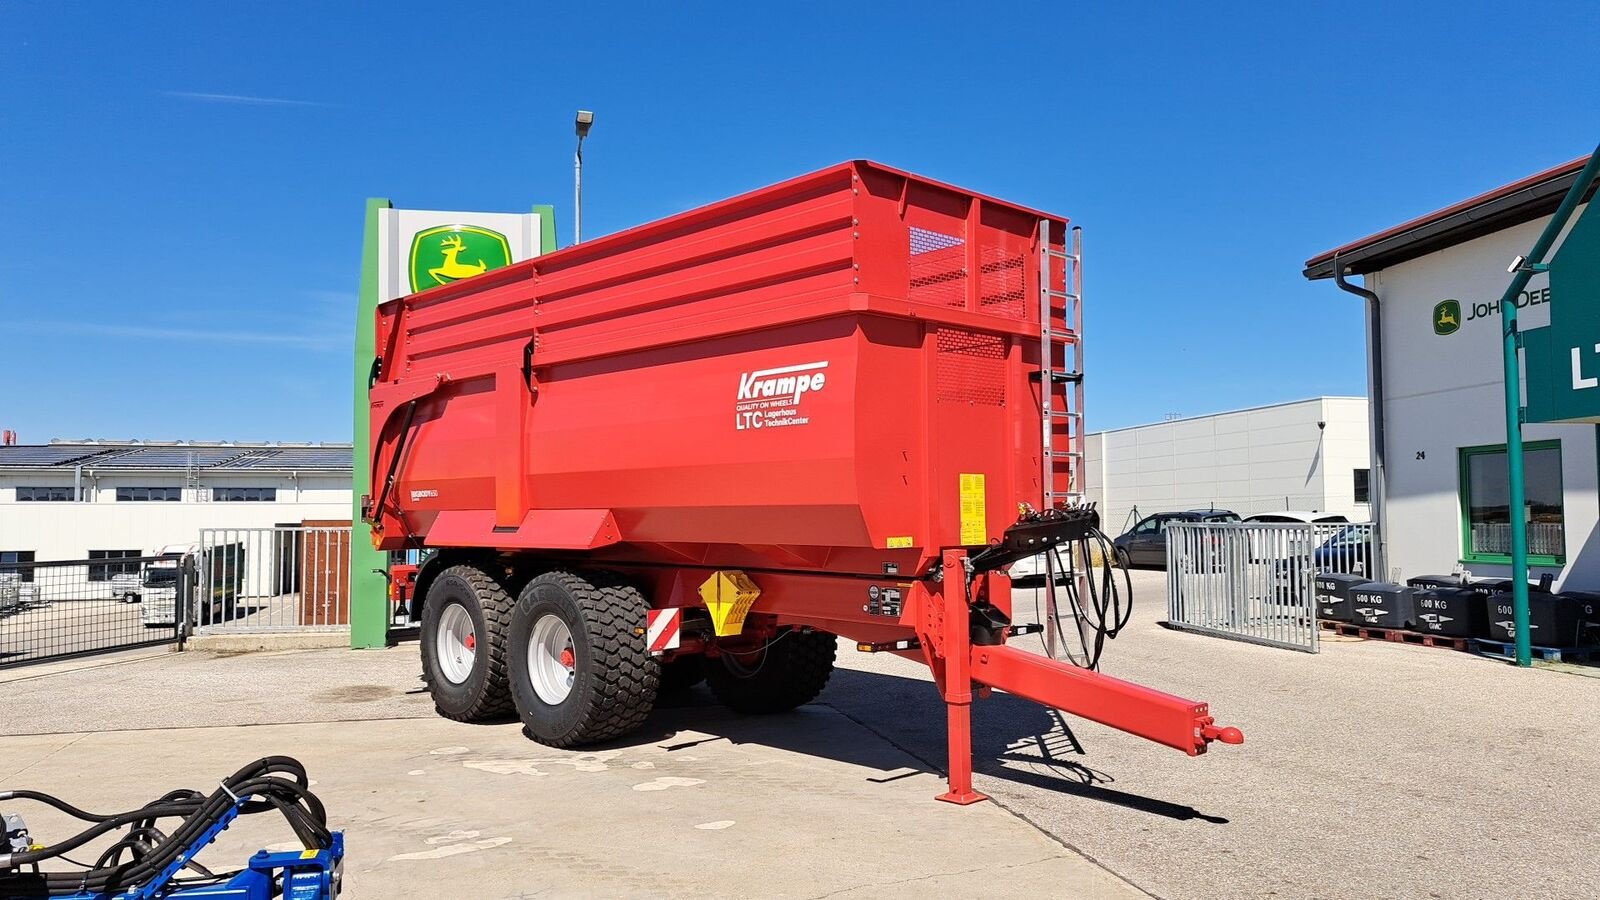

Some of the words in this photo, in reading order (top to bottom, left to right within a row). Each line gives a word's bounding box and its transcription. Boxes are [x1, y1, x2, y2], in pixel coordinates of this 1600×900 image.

[1467, 300, 1503, 321] JOH
[1571, 343, 1600, 390] L
[737, 361, 829, 406] Krampe
[736, 403, 760, 412] QUALITY
[770, 399, 793, 408] WHEELS
[764, 409, 797, 419] Lagerhaus
[736, 411, 763, 430] LTC
[1415, 451, 1425, 460] 24
[1370, 595, 1382, 604] KG
[1420, 599, 1433, 608] 600
[1434, 600, 1447, 609] KG
[1497, 605, 1513, 615] 600
[1428, 622, 1442, 631] GMC
